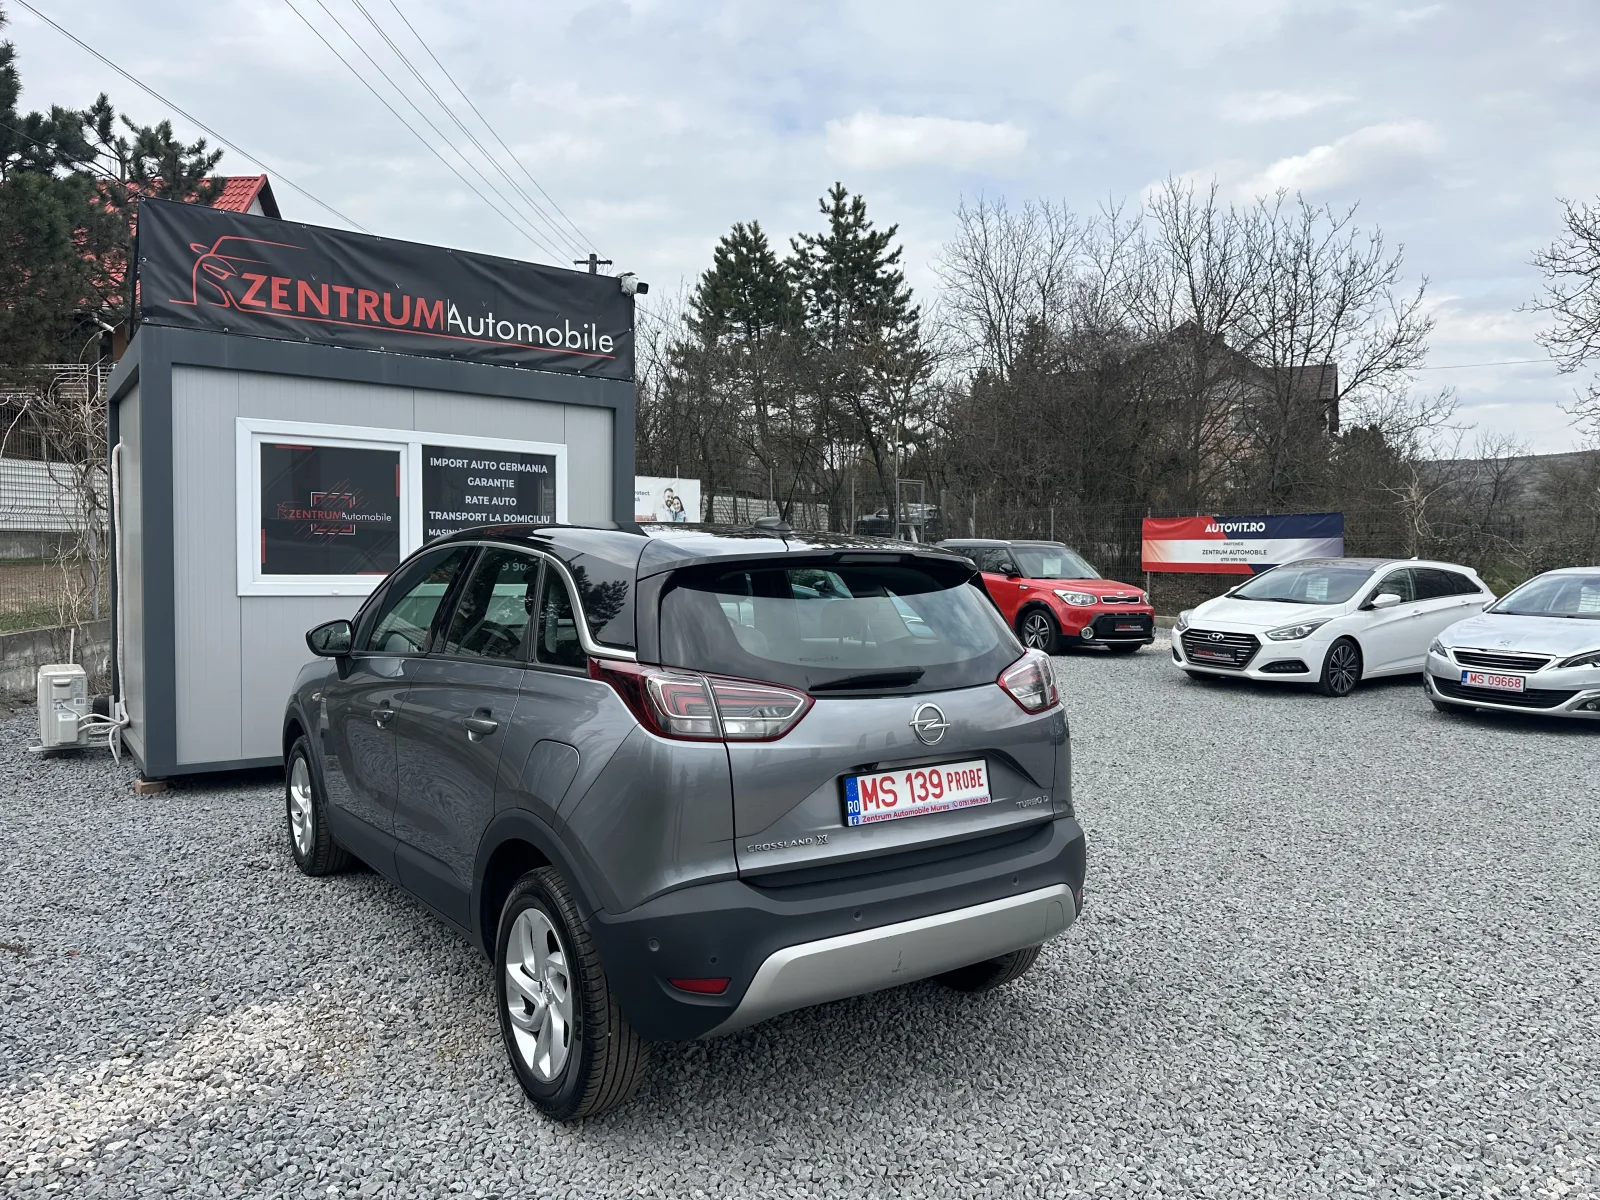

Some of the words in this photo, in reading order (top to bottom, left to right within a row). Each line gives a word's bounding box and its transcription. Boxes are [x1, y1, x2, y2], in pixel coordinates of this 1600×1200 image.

[239, 272, 445, 331] ZENTRUM
[447, 298, 614, 353] Automobile
[430, 457, 469, 469] IMPORT
[470, 460, 497, 470] AUTO
[498, 462, 548, 474] GERMANIA
[465, 495, 489, 505] RATE
[491, 497, 517, 506] AUTO
[288, 509, 342, 520] ZENTRUM
[341, 511, 392, 522] Automobile
[429, 511, 487, 522] TRANSPORT
[489, 513, 501, 522] LA
[503, 513, 550, 524] DOMICILIU
[1204, 522, 1266, 533] AUTOVIT.RO
[1470, 673, 1484, 684] MS
[1488, 675, 1521, 688] 09668
[860, 775, 898, 812] MS
[905, 769, 944, 804] 139
[946, 767, 984, 792] PROBE
[847, 800, 860, 814] RO
[862, 812, 892, 823] Zentrum
[893, 806, 930, 818] Automobile
[930, 804, 950, 812] Mures
[747, 837, 813, 853] CROSSLAND
[816, 834, 829, 846] X
